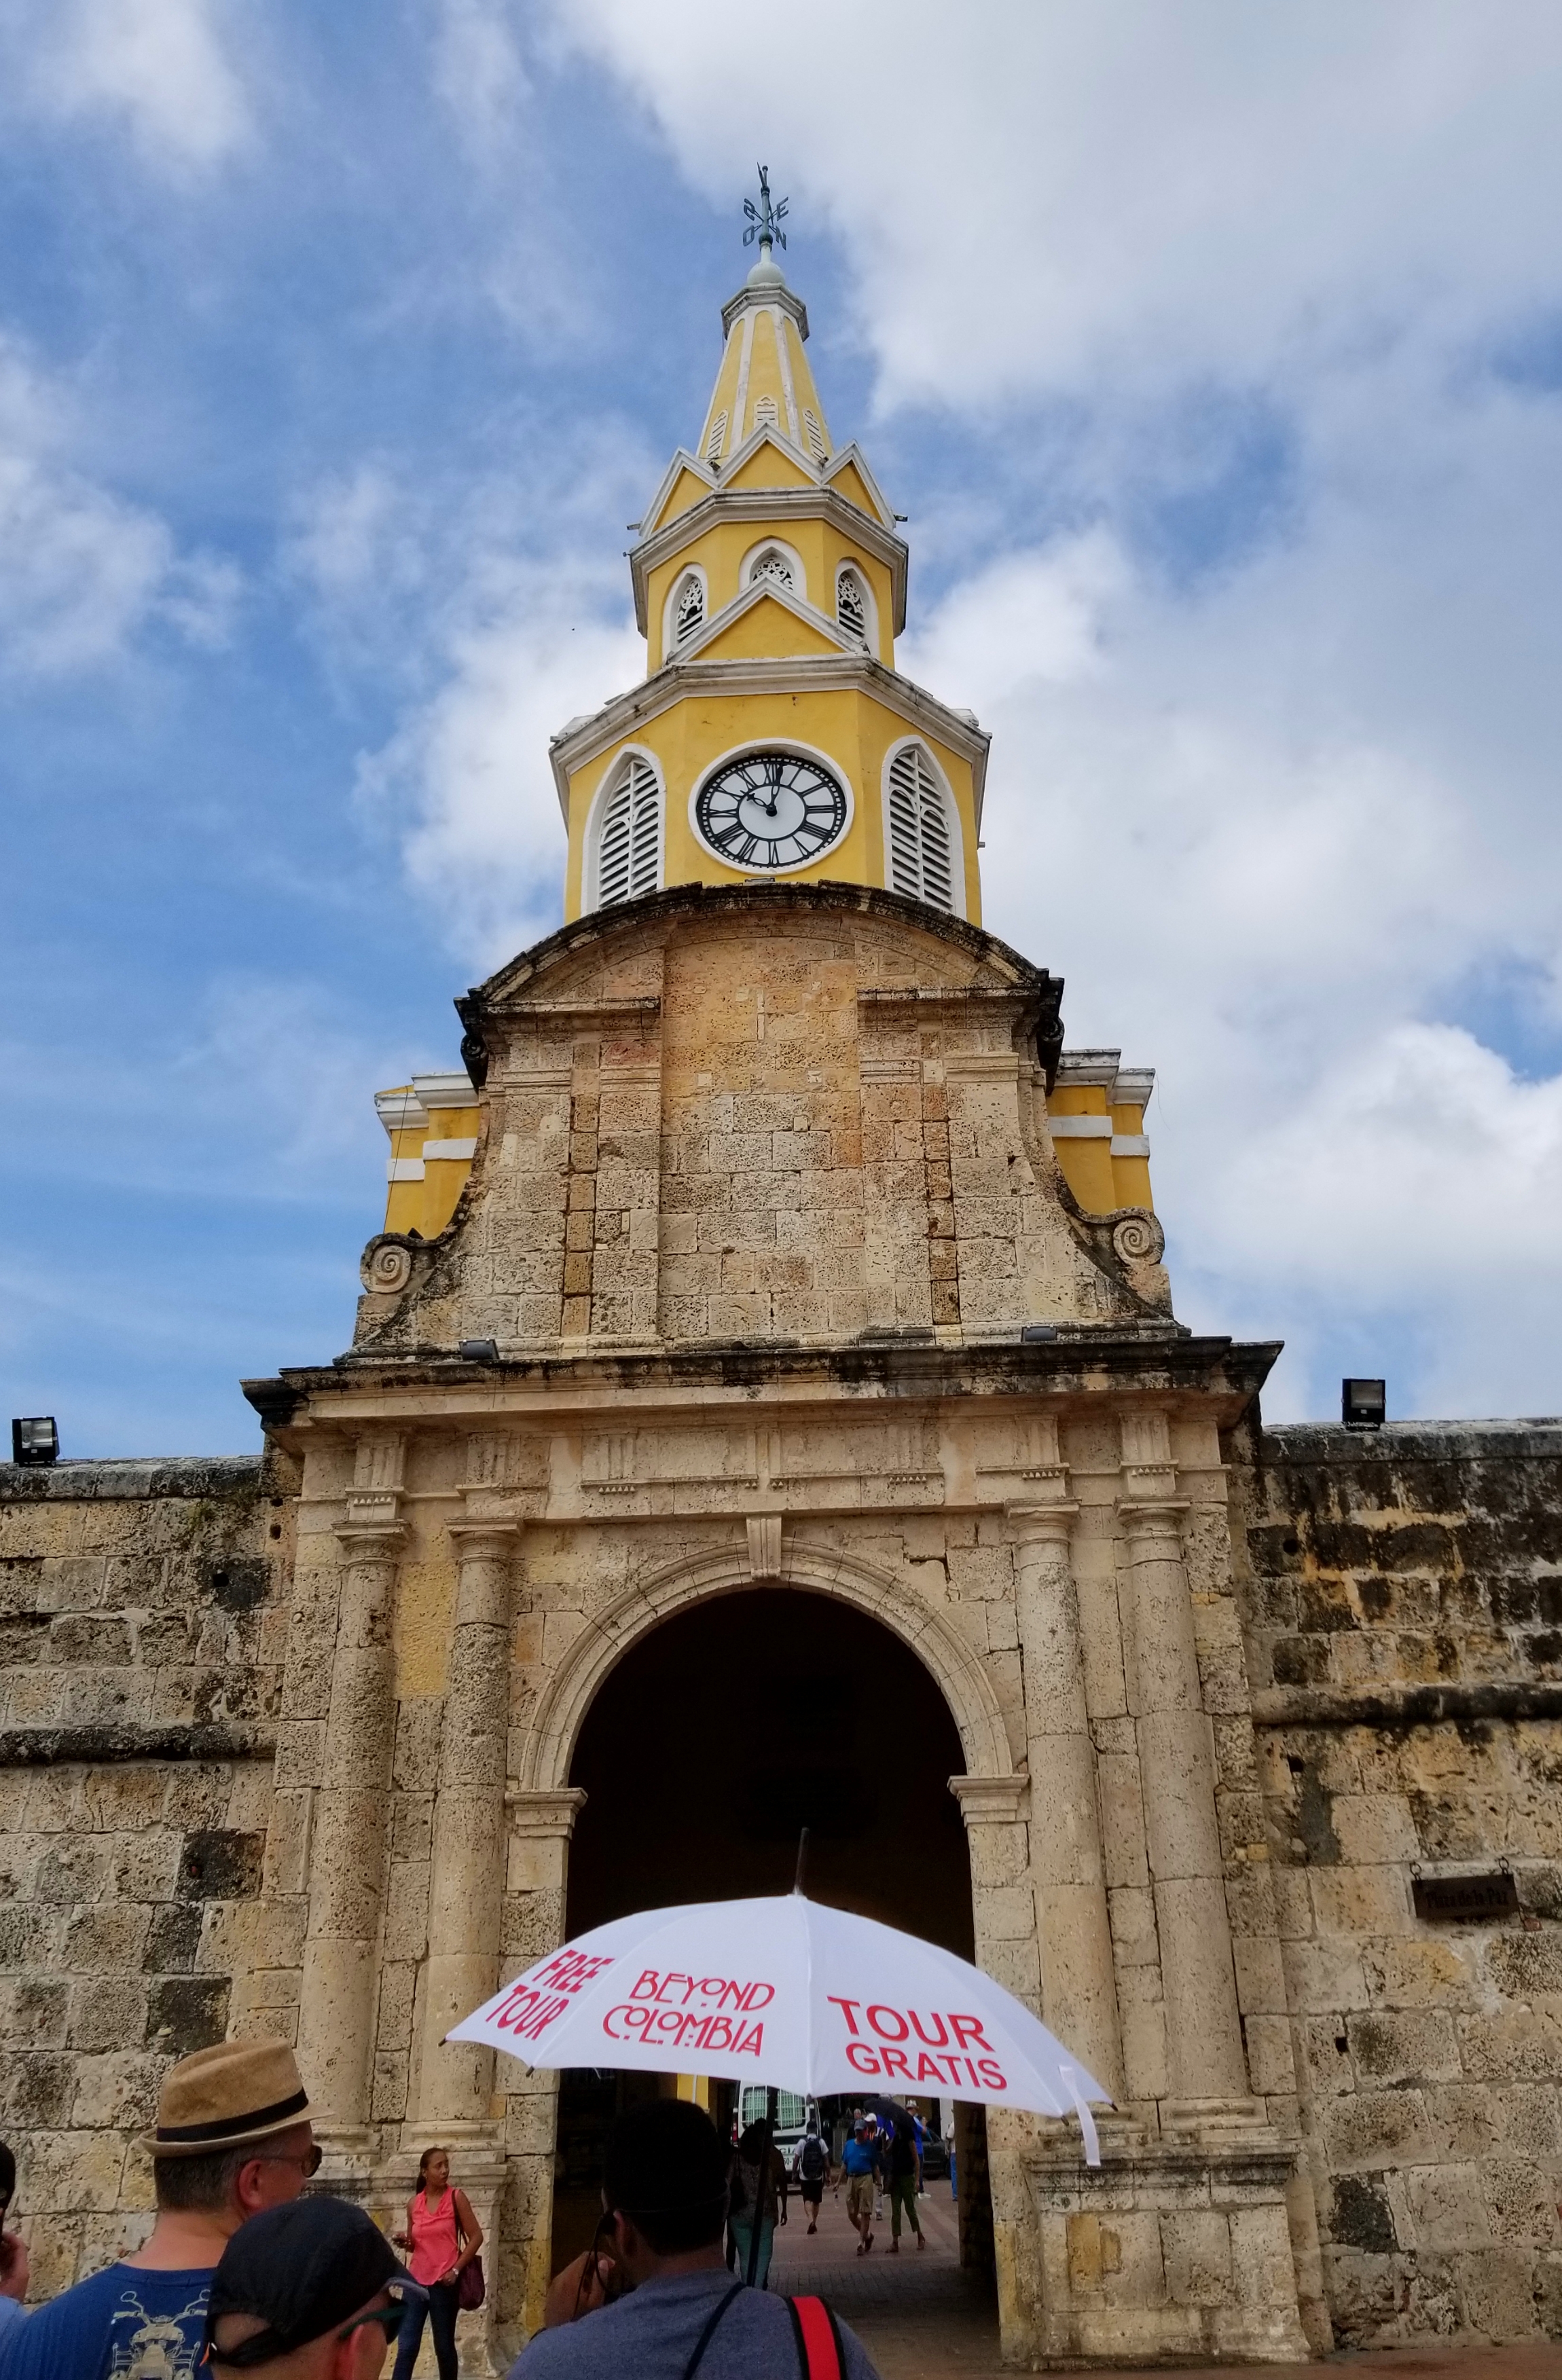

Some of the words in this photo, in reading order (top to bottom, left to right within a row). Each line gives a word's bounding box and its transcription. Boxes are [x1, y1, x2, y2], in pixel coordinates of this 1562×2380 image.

[713, 785, 742, 801] X
[735, 768, 759, 790] XI
[708, 808, 738, 818] IX
[805, 805, 835, 814] III
[767, 840, 780, 864] VI
[532, 1949, 615, 1994] FREE
[629, 1970, 775, 2012] BEYOND
[485, 1984, 570, 2040] TOUR
[602, 2005, 764, 2057] COLOMBIA
[827, 1996, 996, 2053] TOUR
[846, 2043, 1008, 2091] GRATIS
